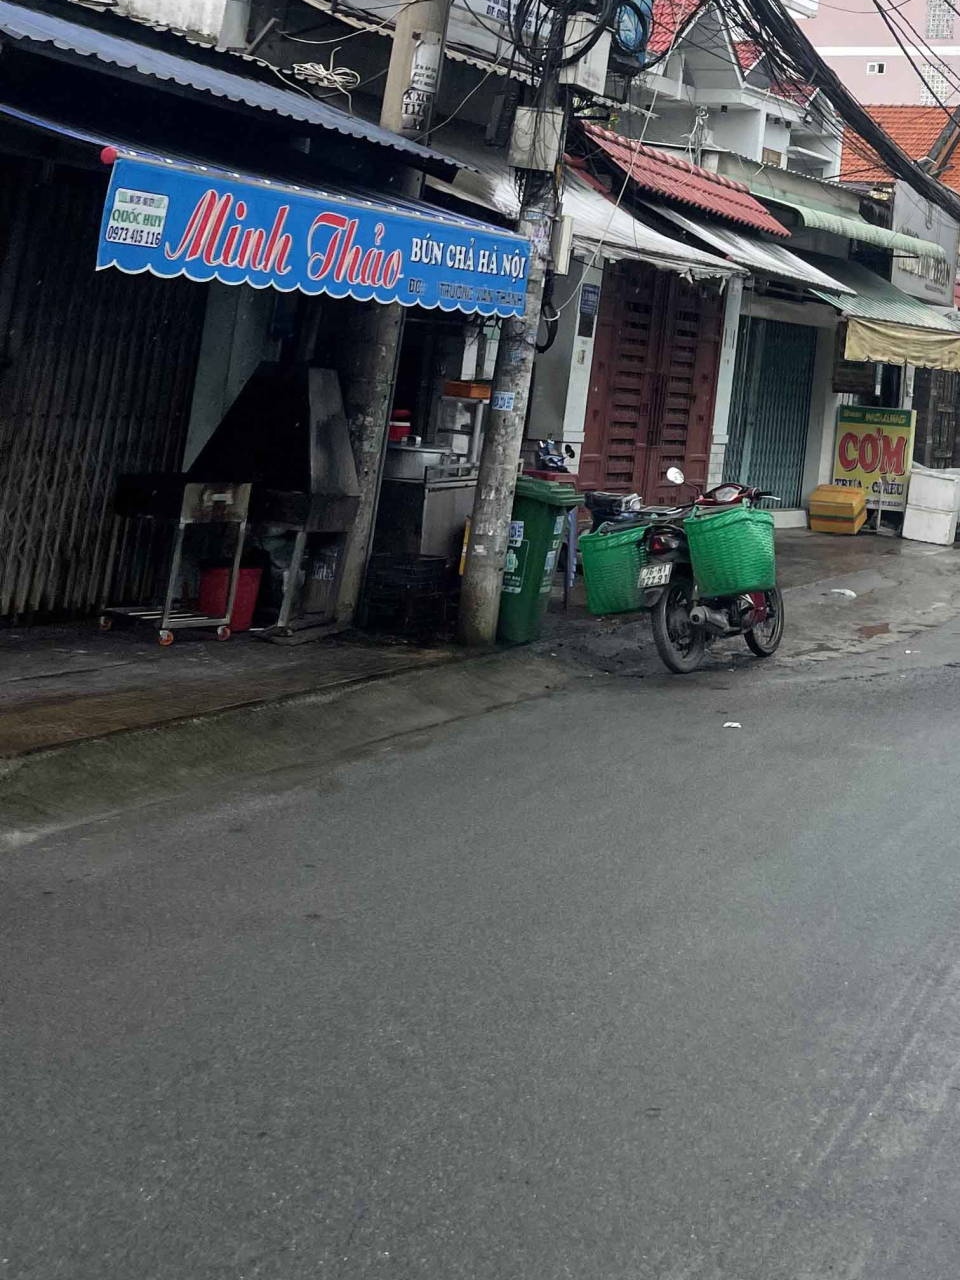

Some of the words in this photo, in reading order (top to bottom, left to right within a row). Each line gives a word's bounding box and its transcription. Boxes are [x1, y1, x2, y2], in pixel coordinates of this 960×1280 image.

[107, 225, 130, 241] 0973
[130, 229, 144, 244] 415
[145, 230, 162, 246] 116
[112, 207, 142, 225] QUỐC
[142, 213, 165, 228] HUY
[165, 189, 292, 275] Minh
[307, 211, 404, 289] Thảo
[410, 233, 444, 266] BÚN
[446, 237, 475, 271] CHẢ
[477, 245, 499, 275] HÀ
[500, 248, 527, 283] NỘI
[839, 427, 907, 476] CƠM
